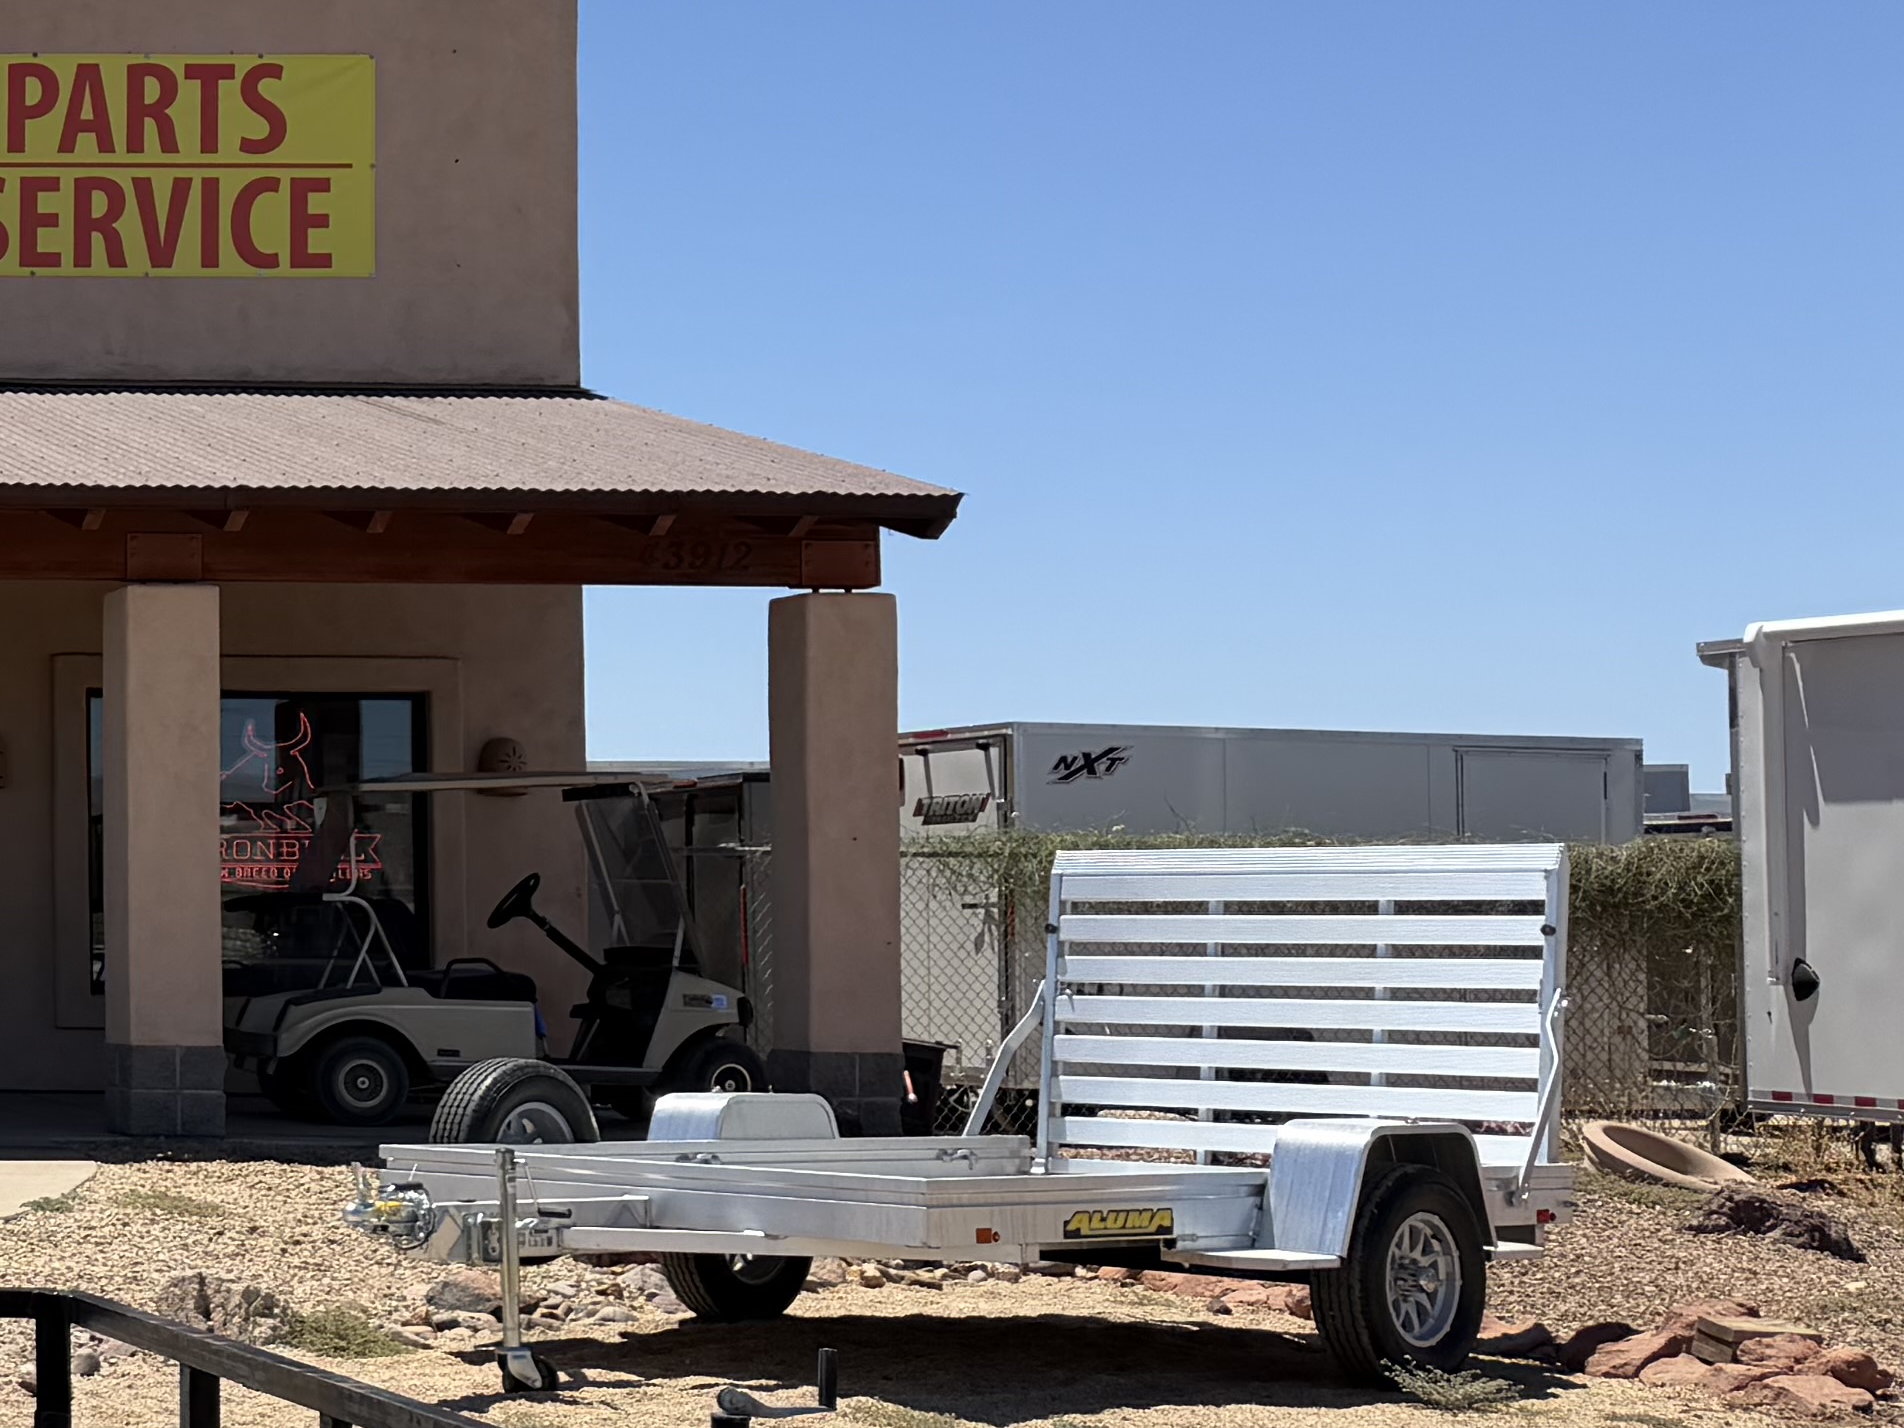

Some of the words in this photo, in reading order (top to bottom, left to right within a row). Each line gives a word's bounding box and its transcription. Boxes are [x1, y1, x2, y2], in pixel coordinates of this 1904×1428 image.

[5, 62, 289, 155] PARTS
[1050, 745, 1129, 783] NXT
[921, 794, 984, 817] TRITON
[1063, 1209, 1174, 1235] ALUMA
